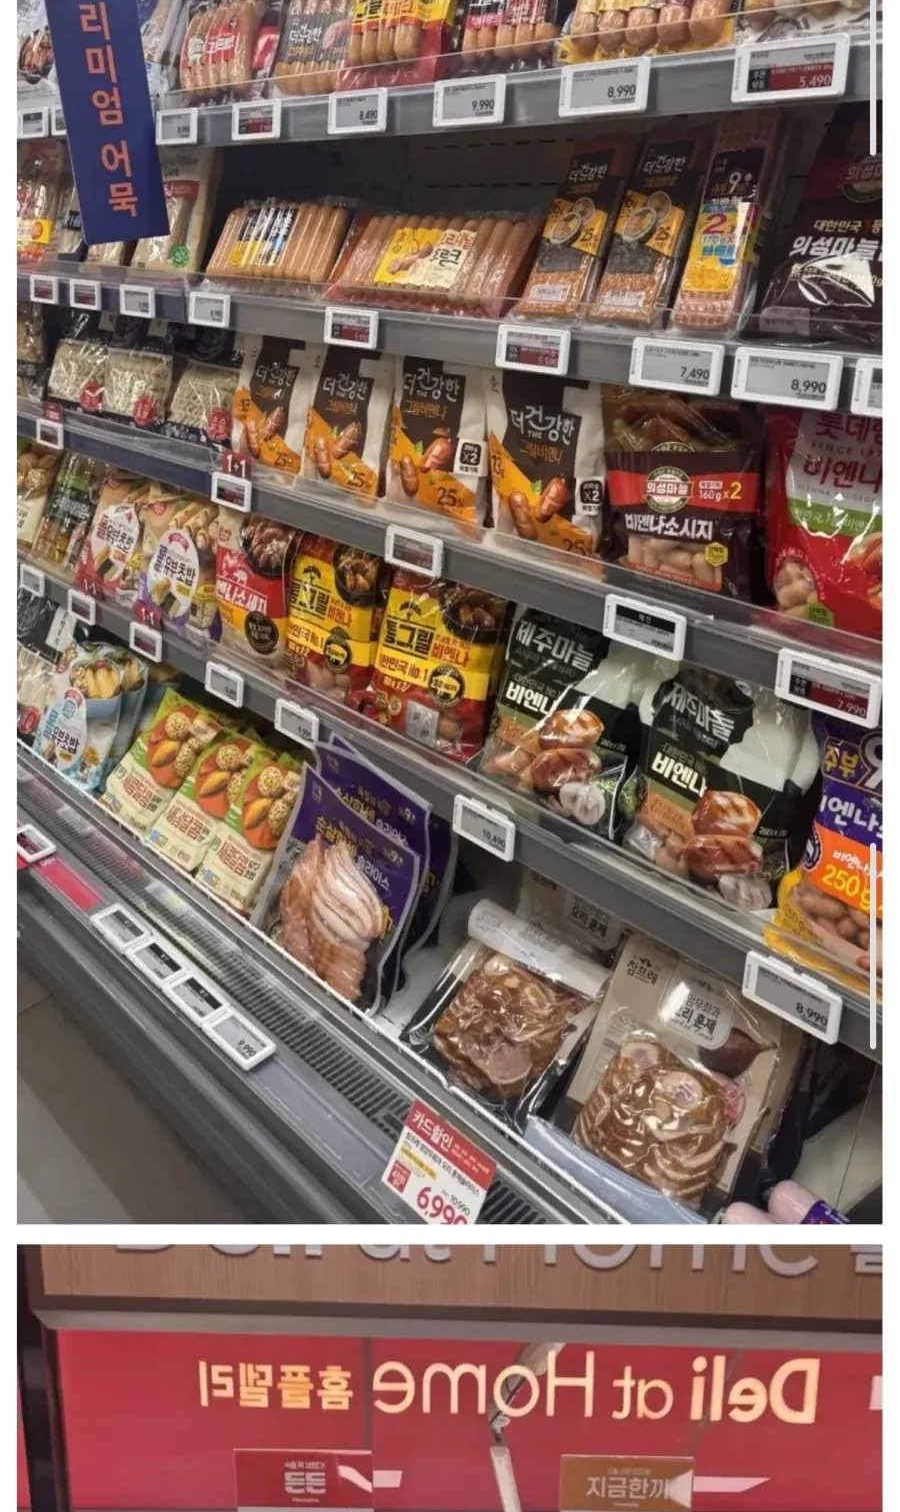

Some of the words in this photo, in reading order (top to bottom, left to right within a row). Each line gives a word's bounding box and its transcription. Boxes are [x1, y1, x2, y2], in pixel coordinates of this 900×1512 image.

[798, 74, 832, 88] 5,490
[607, 84, 636, 98] 8,990
[358, 109, 378, 121] 8,490
[471, 99, 495, 112] 9,990
[101, 139, 139, 218] 어묵
[680, 366, 710, 381] 7,490
[791, 378, 827, 395] 8,990
[510, 404, 576, 447] 더건강한
[624, 512, 714, 541] 비엔나소시지
[836, 699, 867, 718] 7,990
[795, 1002, 828, 1027] 8,990
[411, 1109, 454, 1153] 카드할인
[586, 1476, 669, 1500] 지금한끼
